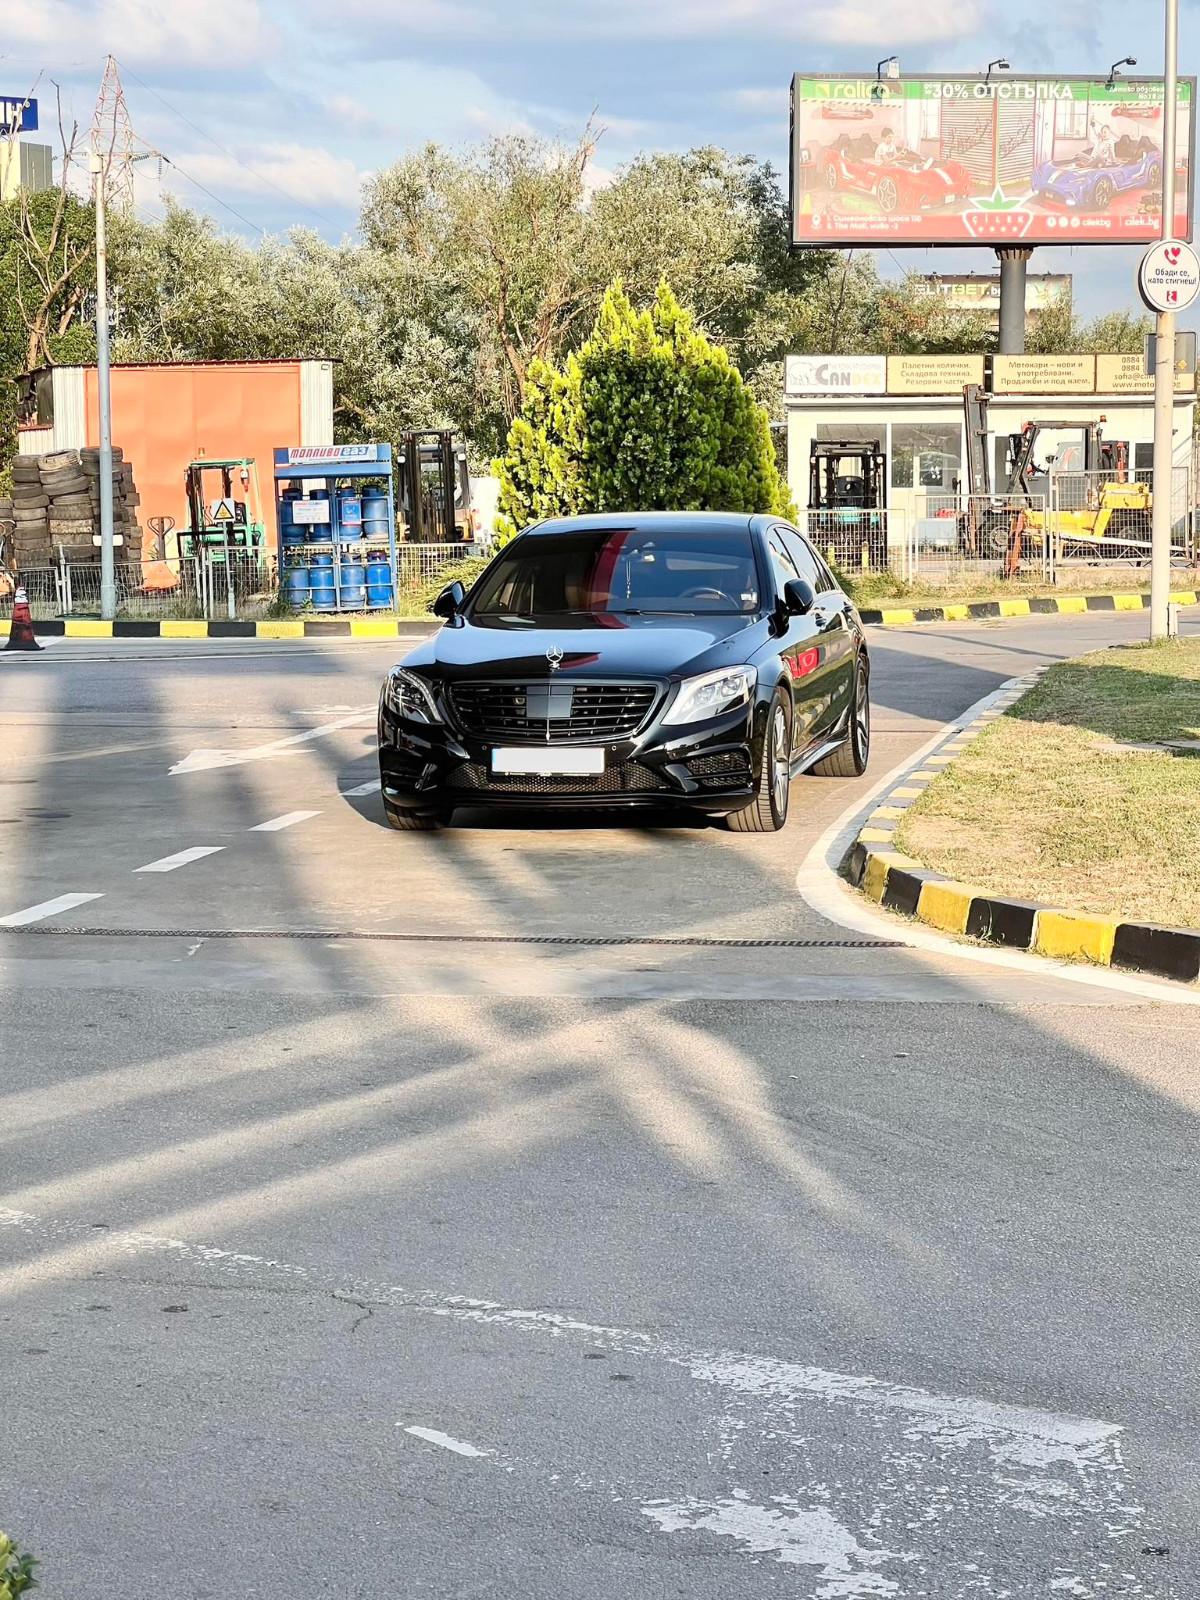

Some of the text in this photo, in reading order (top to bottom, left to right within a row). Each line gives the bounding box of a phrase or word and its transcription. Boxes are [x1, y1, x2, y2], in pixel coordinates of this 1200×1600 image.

[973, 83, 1073, 99] ОТСТЪПКА
[1155, 268, 1178, 277] Обади
[1165, 277, 1197, 285] стигнеш!
[1121, 356, 1140, 364] 0884
[1008, 361, 1048, 369] Мотокари
[1121, 364, 1140, 372] 0884
[1000, 377, 1042, 386] Продажби
